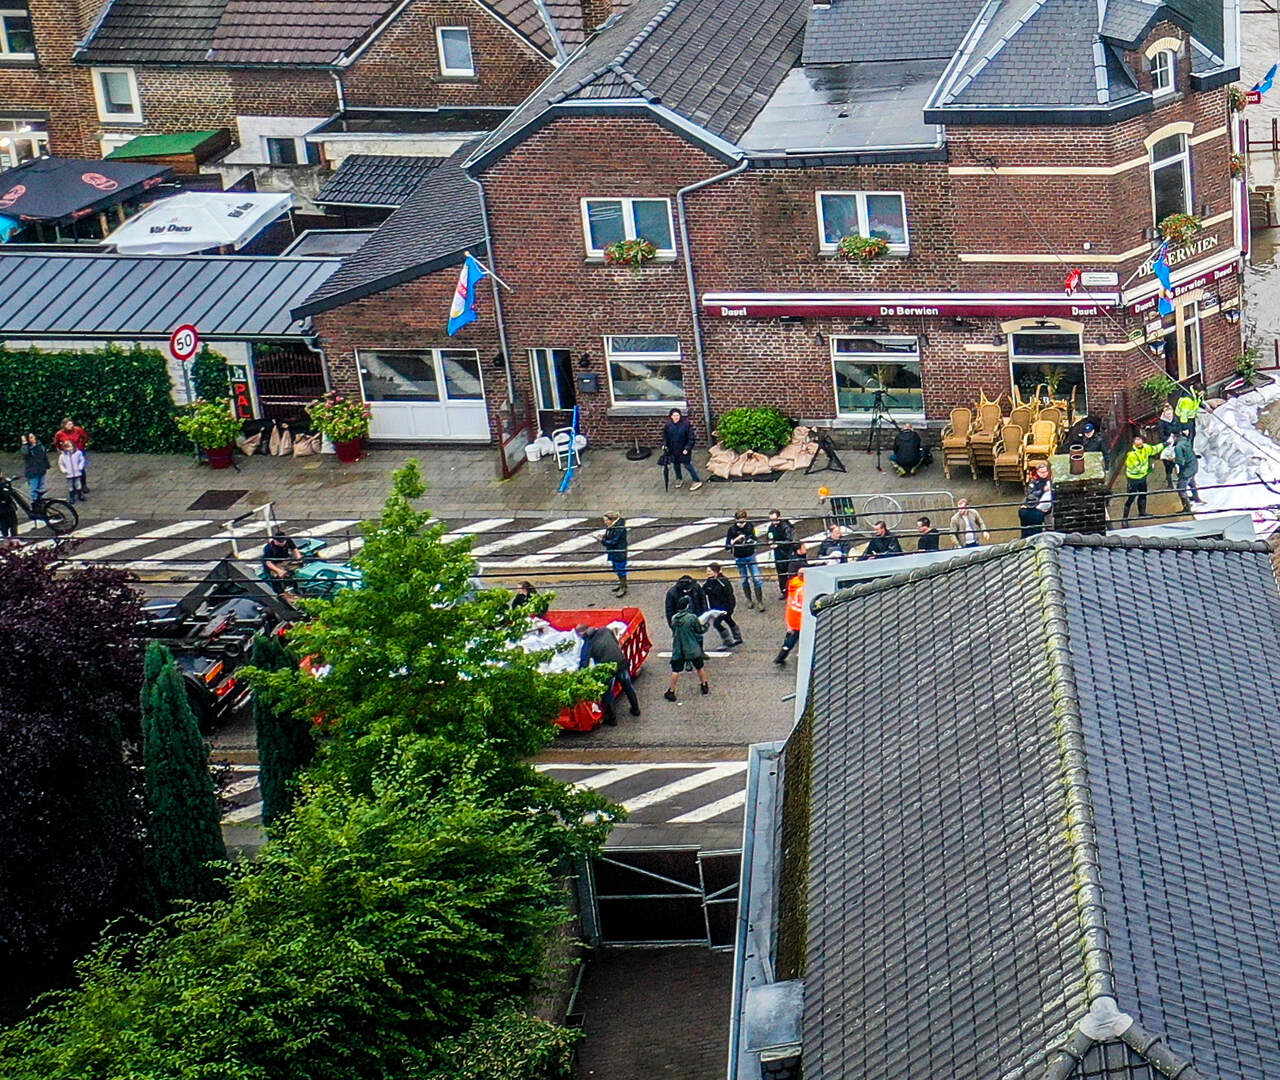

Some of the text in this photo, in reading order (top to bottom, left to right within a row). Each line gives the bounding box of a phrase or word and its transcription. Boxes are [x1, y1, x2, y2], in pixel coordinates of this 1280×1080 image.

[1166, 233, 1218, 266] ERWIEN
[1174, 276, 1207, 297] Berwien
[720, 306, 1098, 317] Duvel De Berwien Duvel
[176, 333, 192, 351] 50
